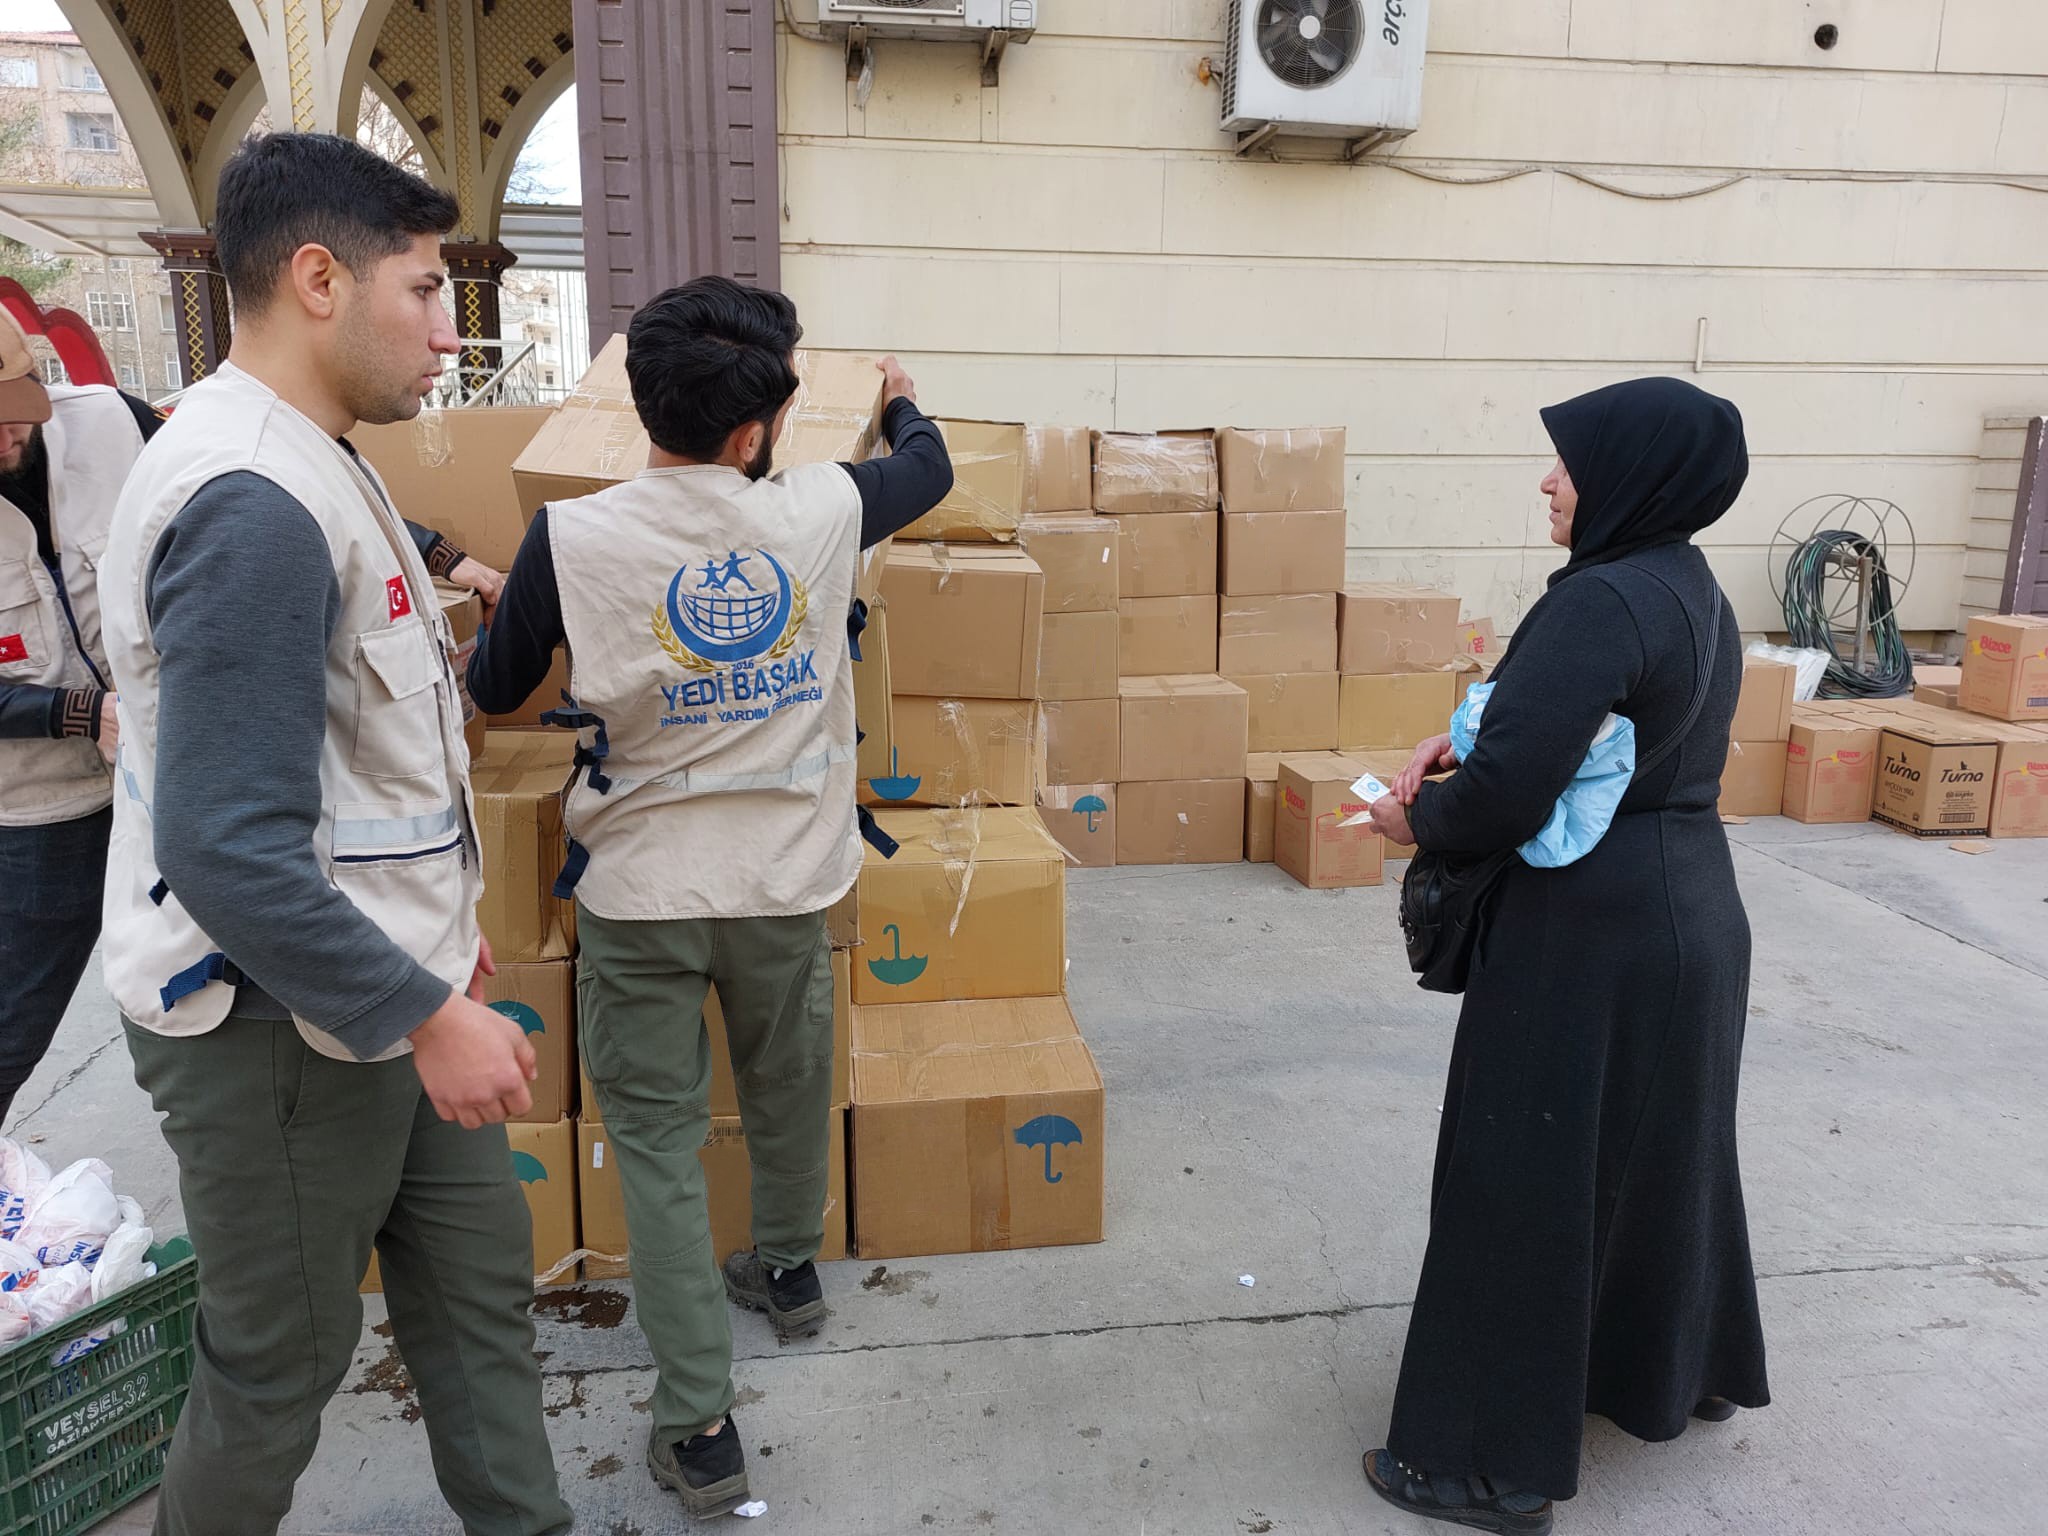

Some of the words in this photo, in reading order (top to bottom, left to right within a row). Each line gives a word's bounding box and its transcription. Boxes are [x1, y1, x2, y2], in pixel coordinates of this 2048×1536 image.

[1383, 0, 1406, 46] arç
[660, 671, 726, 711] YEDİ
[732, 649, 818, 701] BAŞAK
[717, 707, 769, 723] YARDIM
[771, 687, 823, 713] DERNEĞİ
[1883, 755, 1921, 782] Turna
[1940, 769, 1984, 783] Turna
[44, 1390, 123, 1441] VEYSEL
